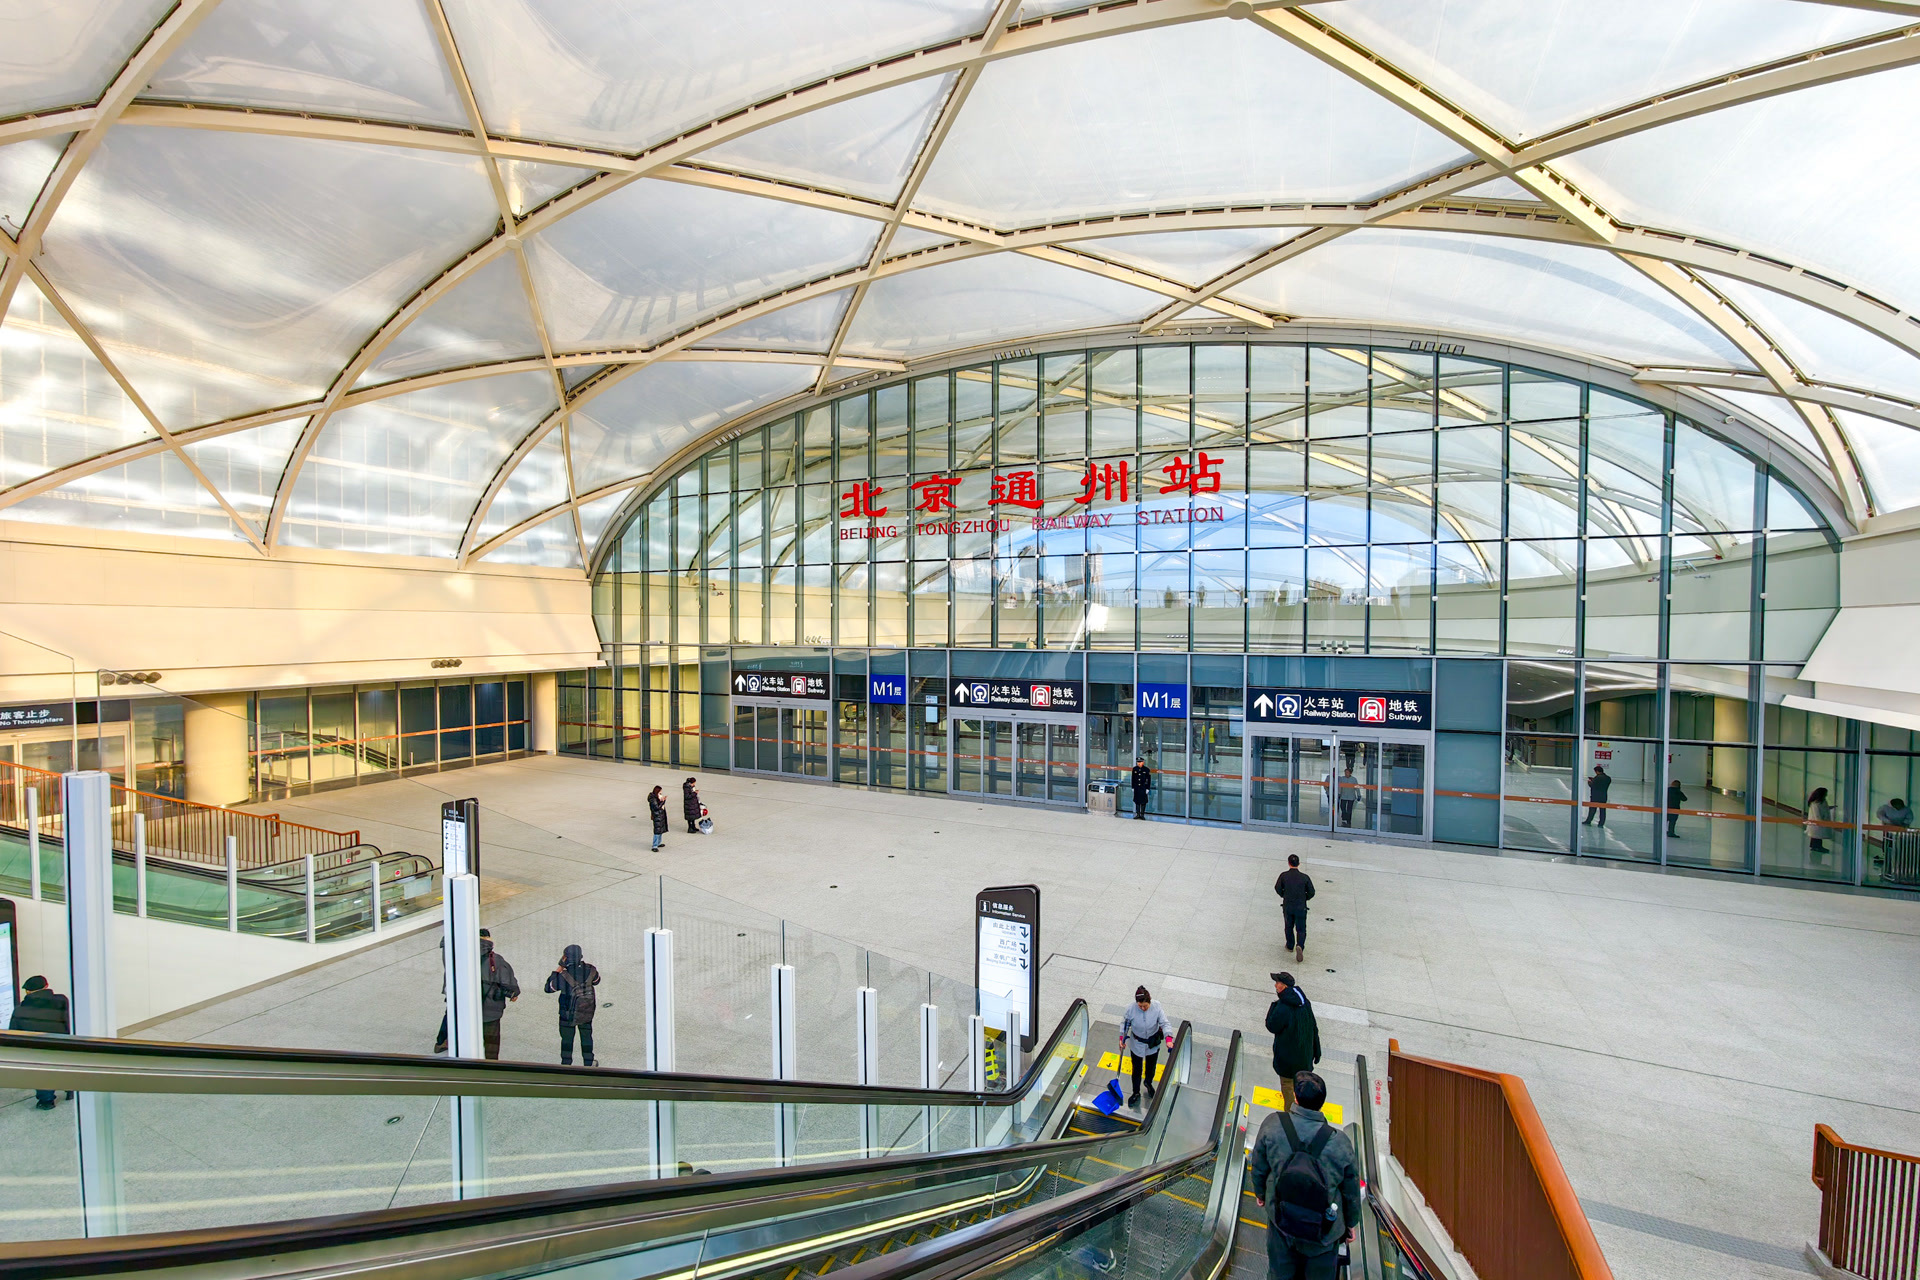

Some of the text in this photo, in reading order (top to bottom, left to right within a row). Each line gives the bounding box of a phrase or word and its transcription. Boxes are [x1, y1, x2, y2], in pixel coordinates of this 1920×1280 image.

[840, 452, 1225, 519] 北京通州站
[840, 506, 1224, 540] BEIJING TONGZHOU RAILWAY STATION
[761, 676, 784, 686] 火车站
[807, 677, 824, 687] 地铁
[761, 685, 777, 693] Railway
[807, 687, 826, 695] Subway
[873, 681, 902, 697] M1层
[991, 685, 1021, 696] 火车站
[1052, 687, 1074, 698] 地铁
[991, 696, 1029, 704] Railway Station
[1052, 698, 1078, 707] Subway
[1142, 691, 1181, 709] M1层
[1304, 696, 1345, 710] 火车站
[1388, 700, 1418, 713] 地铁
[0, 709, 51, 720] 旅客止步
[1303, 709, 1356, 719] Railway Station
[1388, 713, 1423, 723] Subway
[12, 717, 64, 725] Thoroughfare
